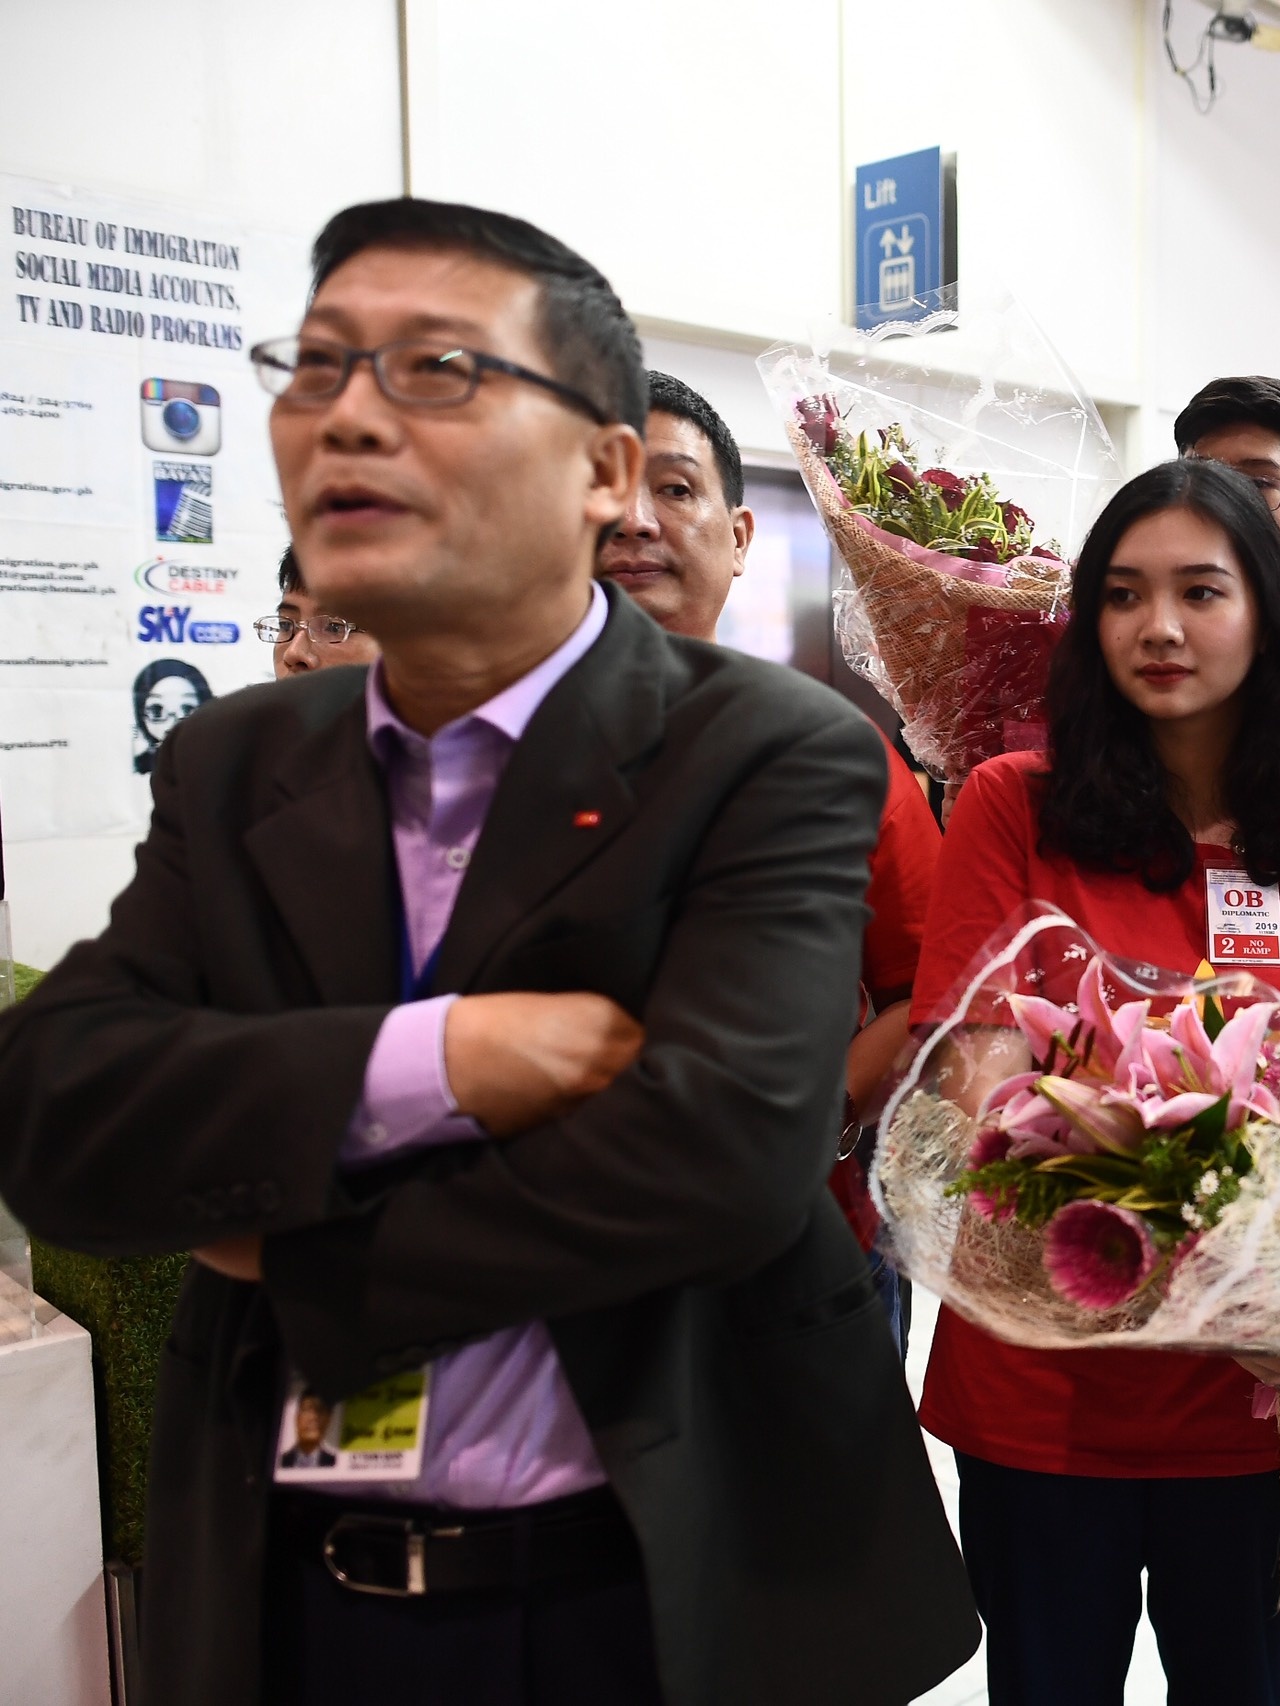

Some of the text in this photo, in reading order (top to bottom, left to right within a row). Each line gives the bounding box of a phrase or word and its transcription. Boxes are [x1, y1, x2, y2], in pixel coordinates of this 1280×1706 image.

[864, 178, 897, 210] Lift
[12, 206, 240, 271] BUREAU OF IMMIGRATION
[16, 250, 241, 313] SOCIAL MEDIA ACCOUNTS,
[17, 294, 243, 351] TV AND RADIO PROGRAMS
[168, 565, 239, 580] DESTINY
[168, 580, 226, 594] CABLE
[138, 605, 192, 643] SKY
[1224, 889, 1264, 908] OB
[1255, 922, 1278, 931] 2019
[1221, 937, 1235, 954] 2
[1243, 947, 1271, 955] RAMP
